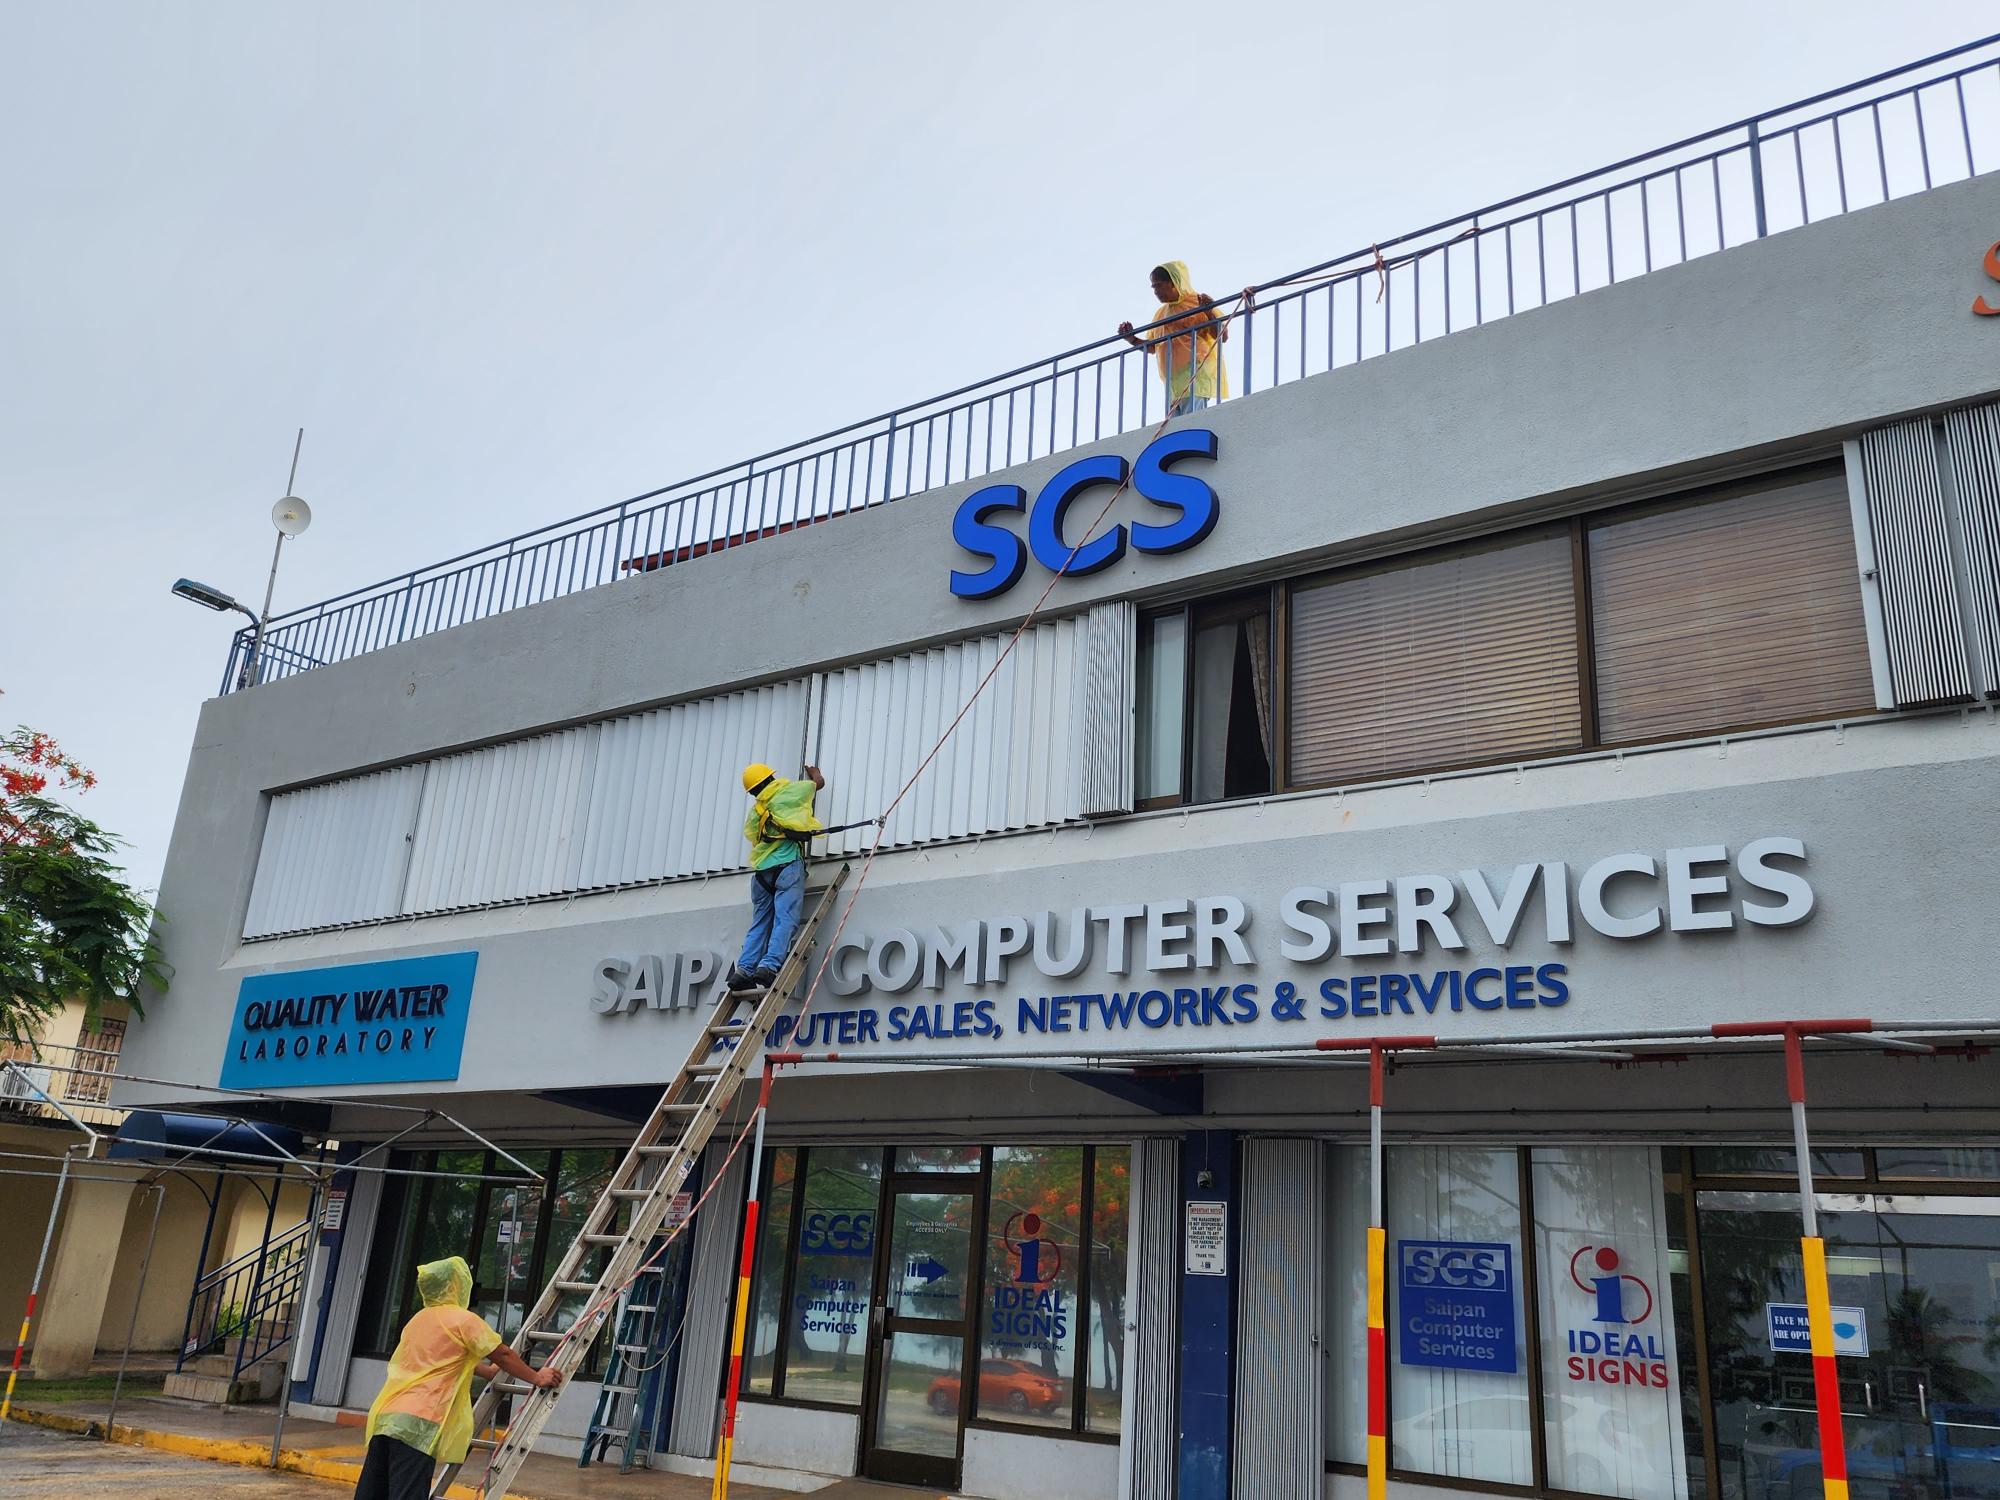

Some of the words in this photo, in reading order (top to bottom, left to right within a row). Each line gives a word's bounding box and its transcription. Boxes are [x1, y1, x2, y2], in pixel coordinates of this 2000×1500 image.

[950, 429, 1220, 600] SCS
[590, 938, 806, 1017] SAIP
[826, 895, 1257, 997] COMPUTER
[1280, 837, 1817, 964] SERVICES
[244, 993, 348, 1032] QUALITY
[354, 984, 449, 1023] WATER
[888, 1000, 1003, 1040] SALES,
[1018, 984, 1259, 1034] NETWORKS
[1271, 981, 1306, 1021] &
[1320, 963, 1569, 1019] SERVICES
[240, 1027, 436, 1062] LABORATORY
[806, 1213, 870, 1250] SCS
[1411, 1250, 1496, 1287] SCS
[810, 1274, 856, 1295] Saipan
[795, 1294, 867, 1316] Computer
[994, 1286, 1066, 1313] IDEAL
[1425, 1298, 1486, 1325] Saipan
[800, 1315, 857, 1335] Services
[992, 1310, 1067, 1339] SIGNS
[1408, 1316, 1503, 1343] Computer
[1773, 1330, 1789, 1340] ARE
[1774, 1315, 1794, 1326] FACE
[1418, 1338, 1495, 1360] Services
[1568, 1329, 1664, 1360] IDEAL
[1567, 1356, 1669, 1388] SIGNS
